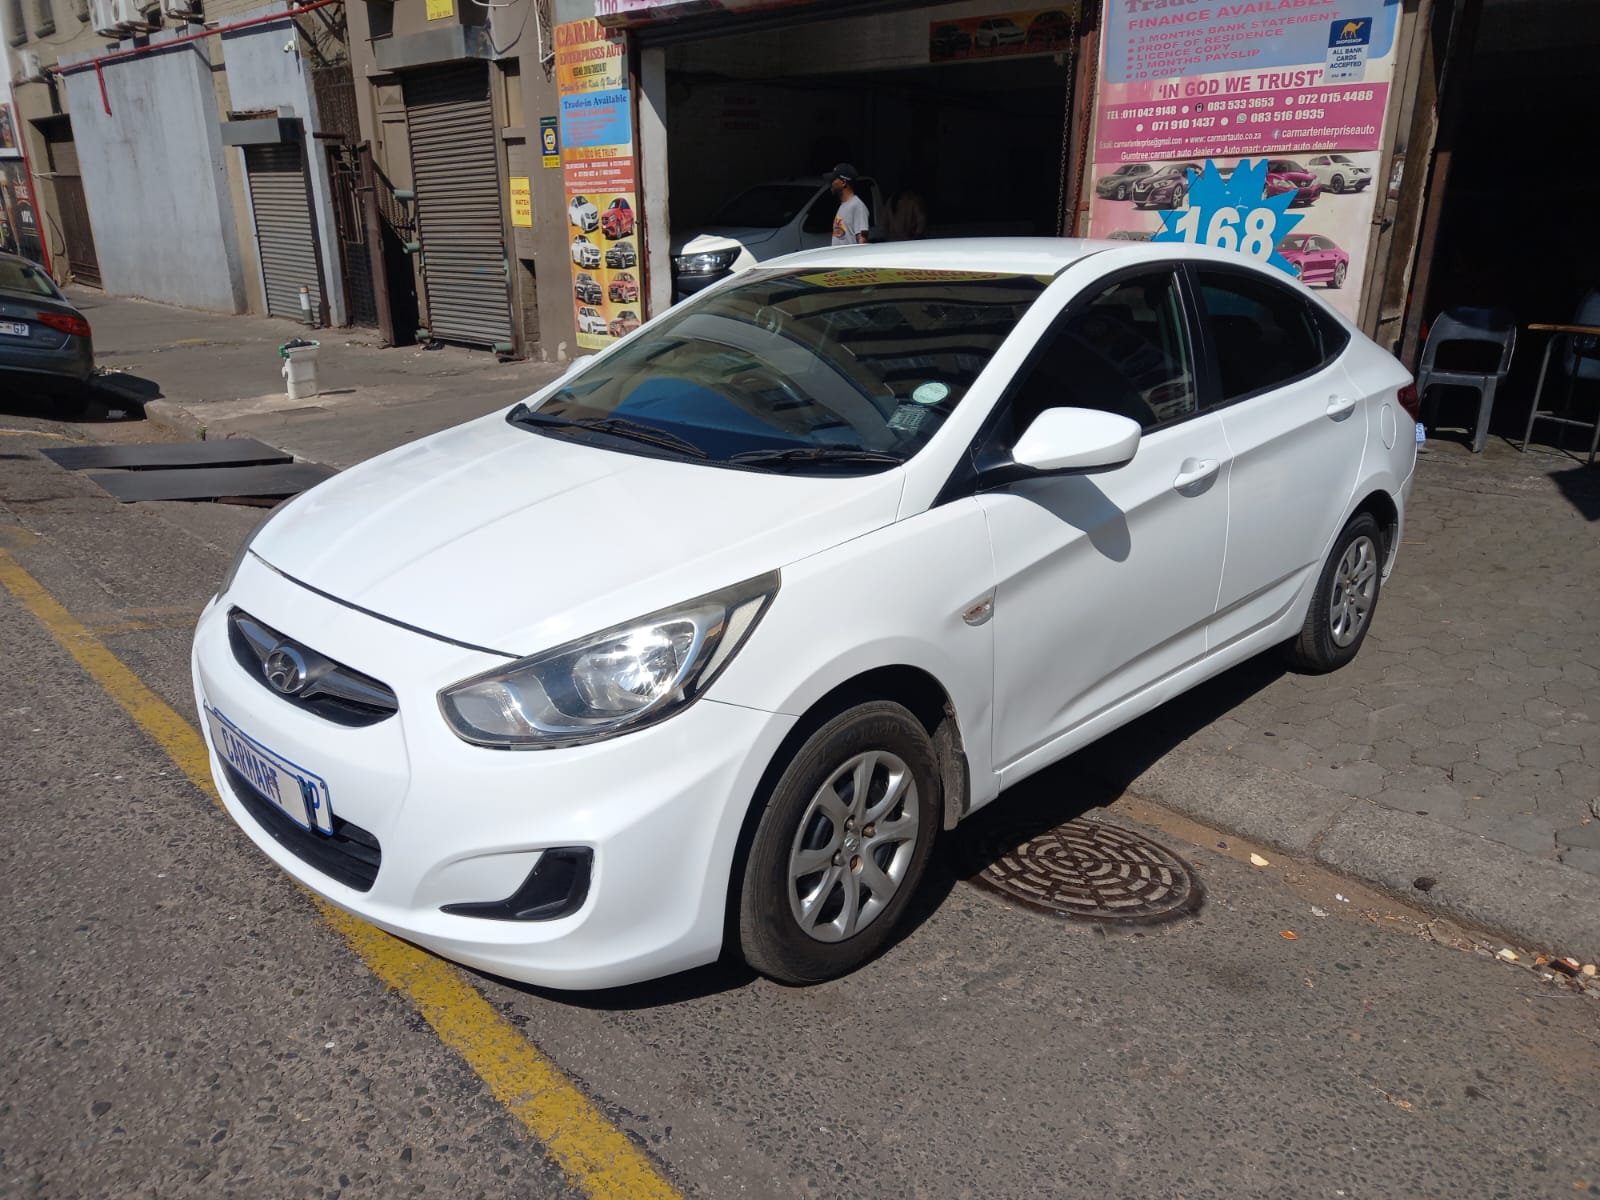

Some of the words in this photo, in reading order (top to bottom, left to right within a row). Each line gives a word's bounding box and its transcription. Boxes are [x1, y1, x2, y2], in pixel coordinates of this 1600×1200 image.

[1128, 9, 1210, 30] FINANCE
[1149, 28, 1204, 42] MONTHS
[1208, 22, 1246, 34] BANK
[1251, 11, 1340, 28] STATEMENT
[1137, 41, 1181, 53] PROOF
[1183, 38, 1201, 47] OF
[1205, 28, 1284, 44] RESIDENCE
[606, 42, 625, 58] AUTO
[1136, 48, 1192, 62] LICENCE
[1195, 43, 1231, 54] COPY
[1136, 62, 1143, 70] 3
[1147, 56, 1201, 68] MONTHS
[1205, 48, 1261, 61] PAYSLIP
[1330, 61, 1362, 69] ACCEPTED
[1135, 71, 1148, 79] ID
[1151, 67, 1186, 77] COPY
[1185, 80, 1219, 97] GOD
[1225, 76, 1251, 93] WE
[593, 94, 627, 106] Available
[1207, 101, 1226, 111] 083
[1227, 99, 1247, 109] 533
[1248, 97, 1275, 109] 3653
[1298, 94, 1318, 105] 072
[1342, 90, 1374, 102] 4488
[1138, 107, 1154, 117] 042
[1155, 105, 1177, 116] 9148
[1251, 112, 1272, 123] 083
[1273, 110, 1293, 121] 516
[1295, 109, 1325, 120] 0935
[1152, 121, 1169, 131] 071
[1170, 119, 1190, 129] 910
[1191, 117, 1216, 128] 1437
[1177, 149, 1191, 157] auto
[1192, 147, 1214, 157] dealer
[1222, 145, 1240, 154] Auto
[13, 323, 26, 335] GP
[221, 727, 283, 805] CARMART
